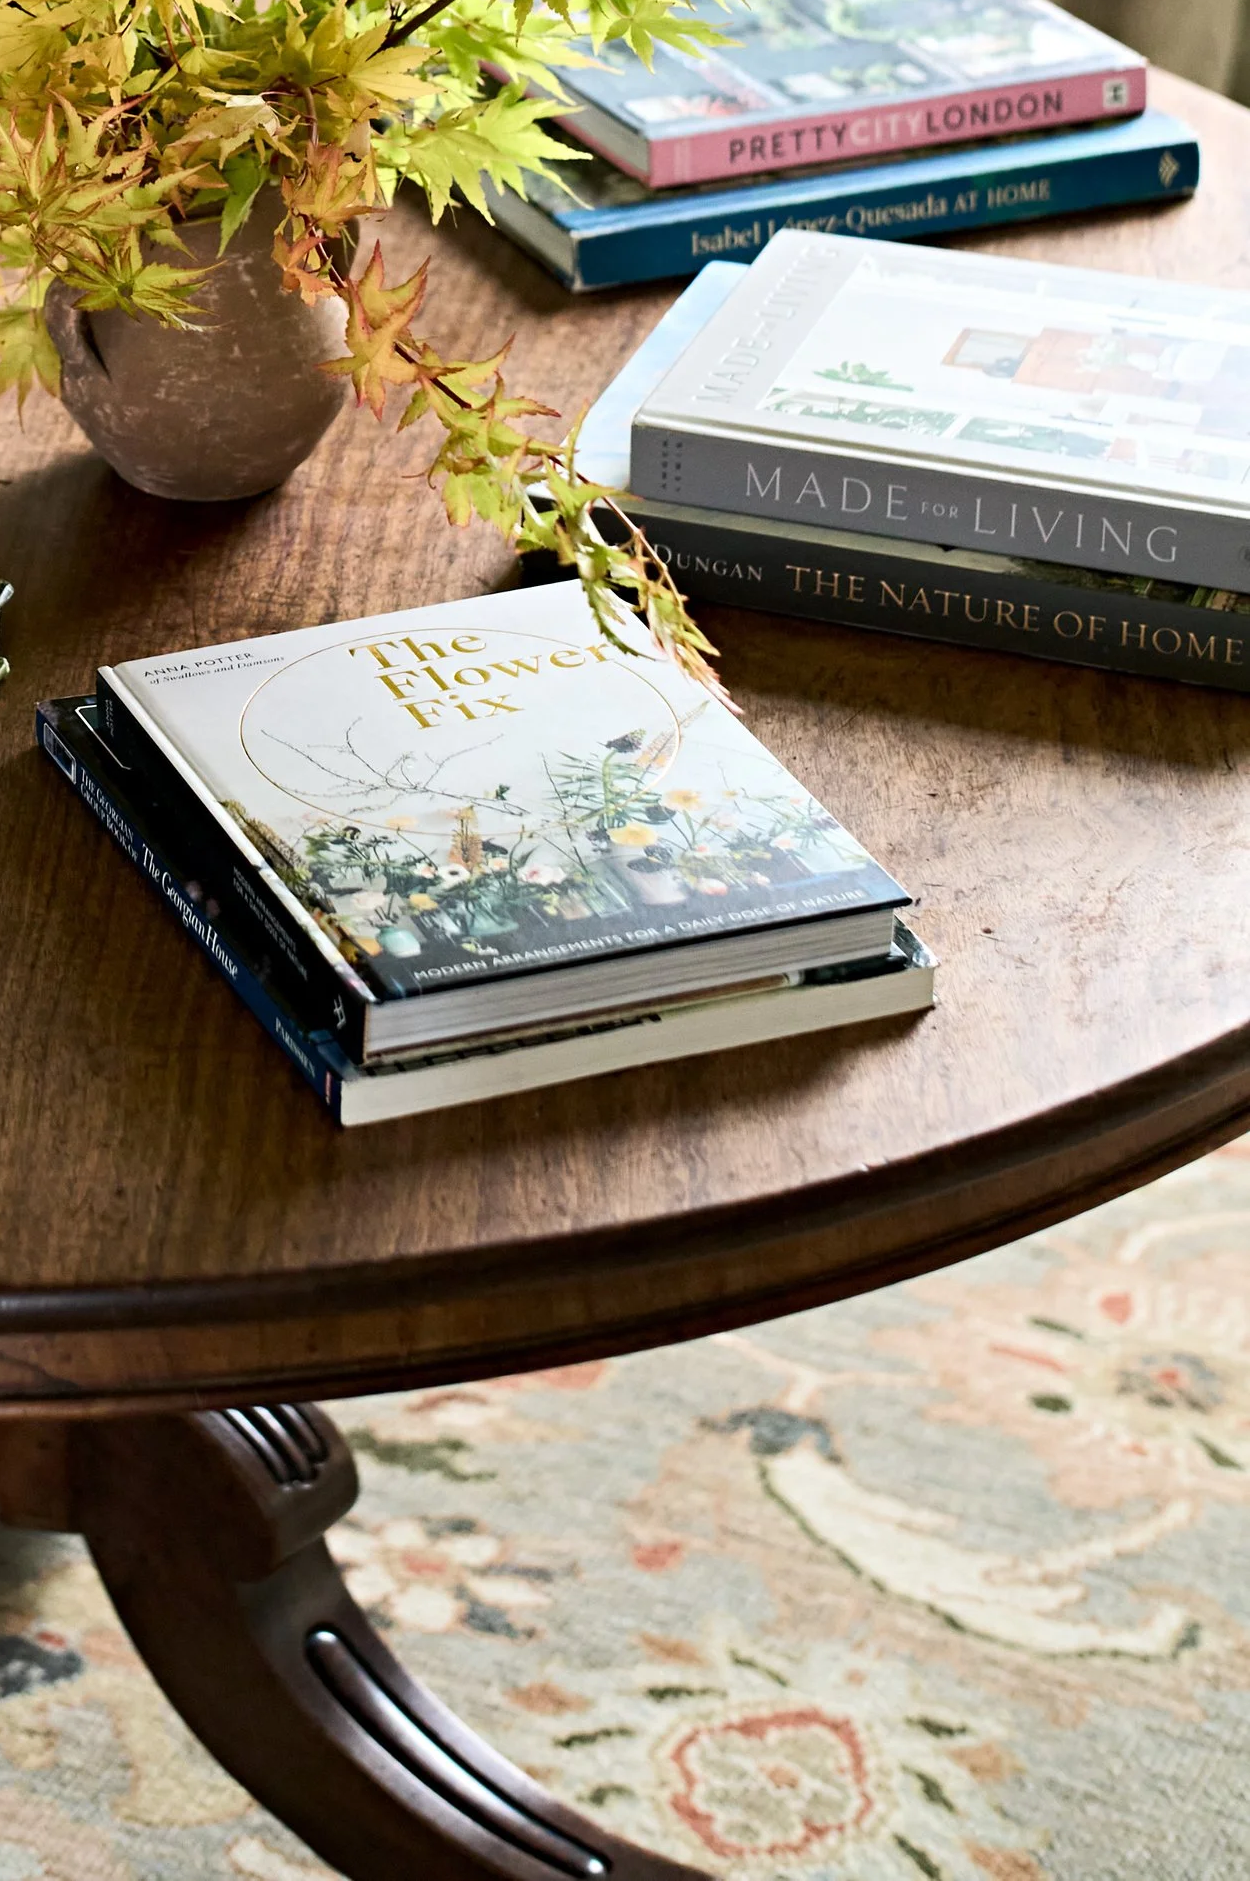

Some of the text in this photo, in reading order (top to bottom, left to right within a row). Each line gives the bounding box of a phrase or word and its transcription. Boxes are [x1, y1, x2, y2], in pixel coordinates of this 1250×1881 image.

[691, 220, 761, 256] Isabel
[953, 191, 979, 214] AT
[987, 179, 1051, 208] HOME
[745, 462, 909, 521] MADE
[921, 502, 958, 521] FOR
[974, 497, 1178, 563] LIVING
[786, 565, 865, 602] THE
[880, 579, 1041, 632] NATURE
[1053, 610, 1107, 641] OF
[1121, 620, 1245, 665] HOME
[144, 652, 254, 678] ANNA POTTER
[150, 656, 285, 685] of Swallows and Damsons
[348, 635, 487, 670] The
[374, 643, 610, 701] Flower
[398, 694, 525, 730] Fix
[142, 843, 239, 980] The Georgian House
[413, 889, 867, 981] MODERN ARRANGEMENTS FOR A DAILY DOSE OF NATURE
